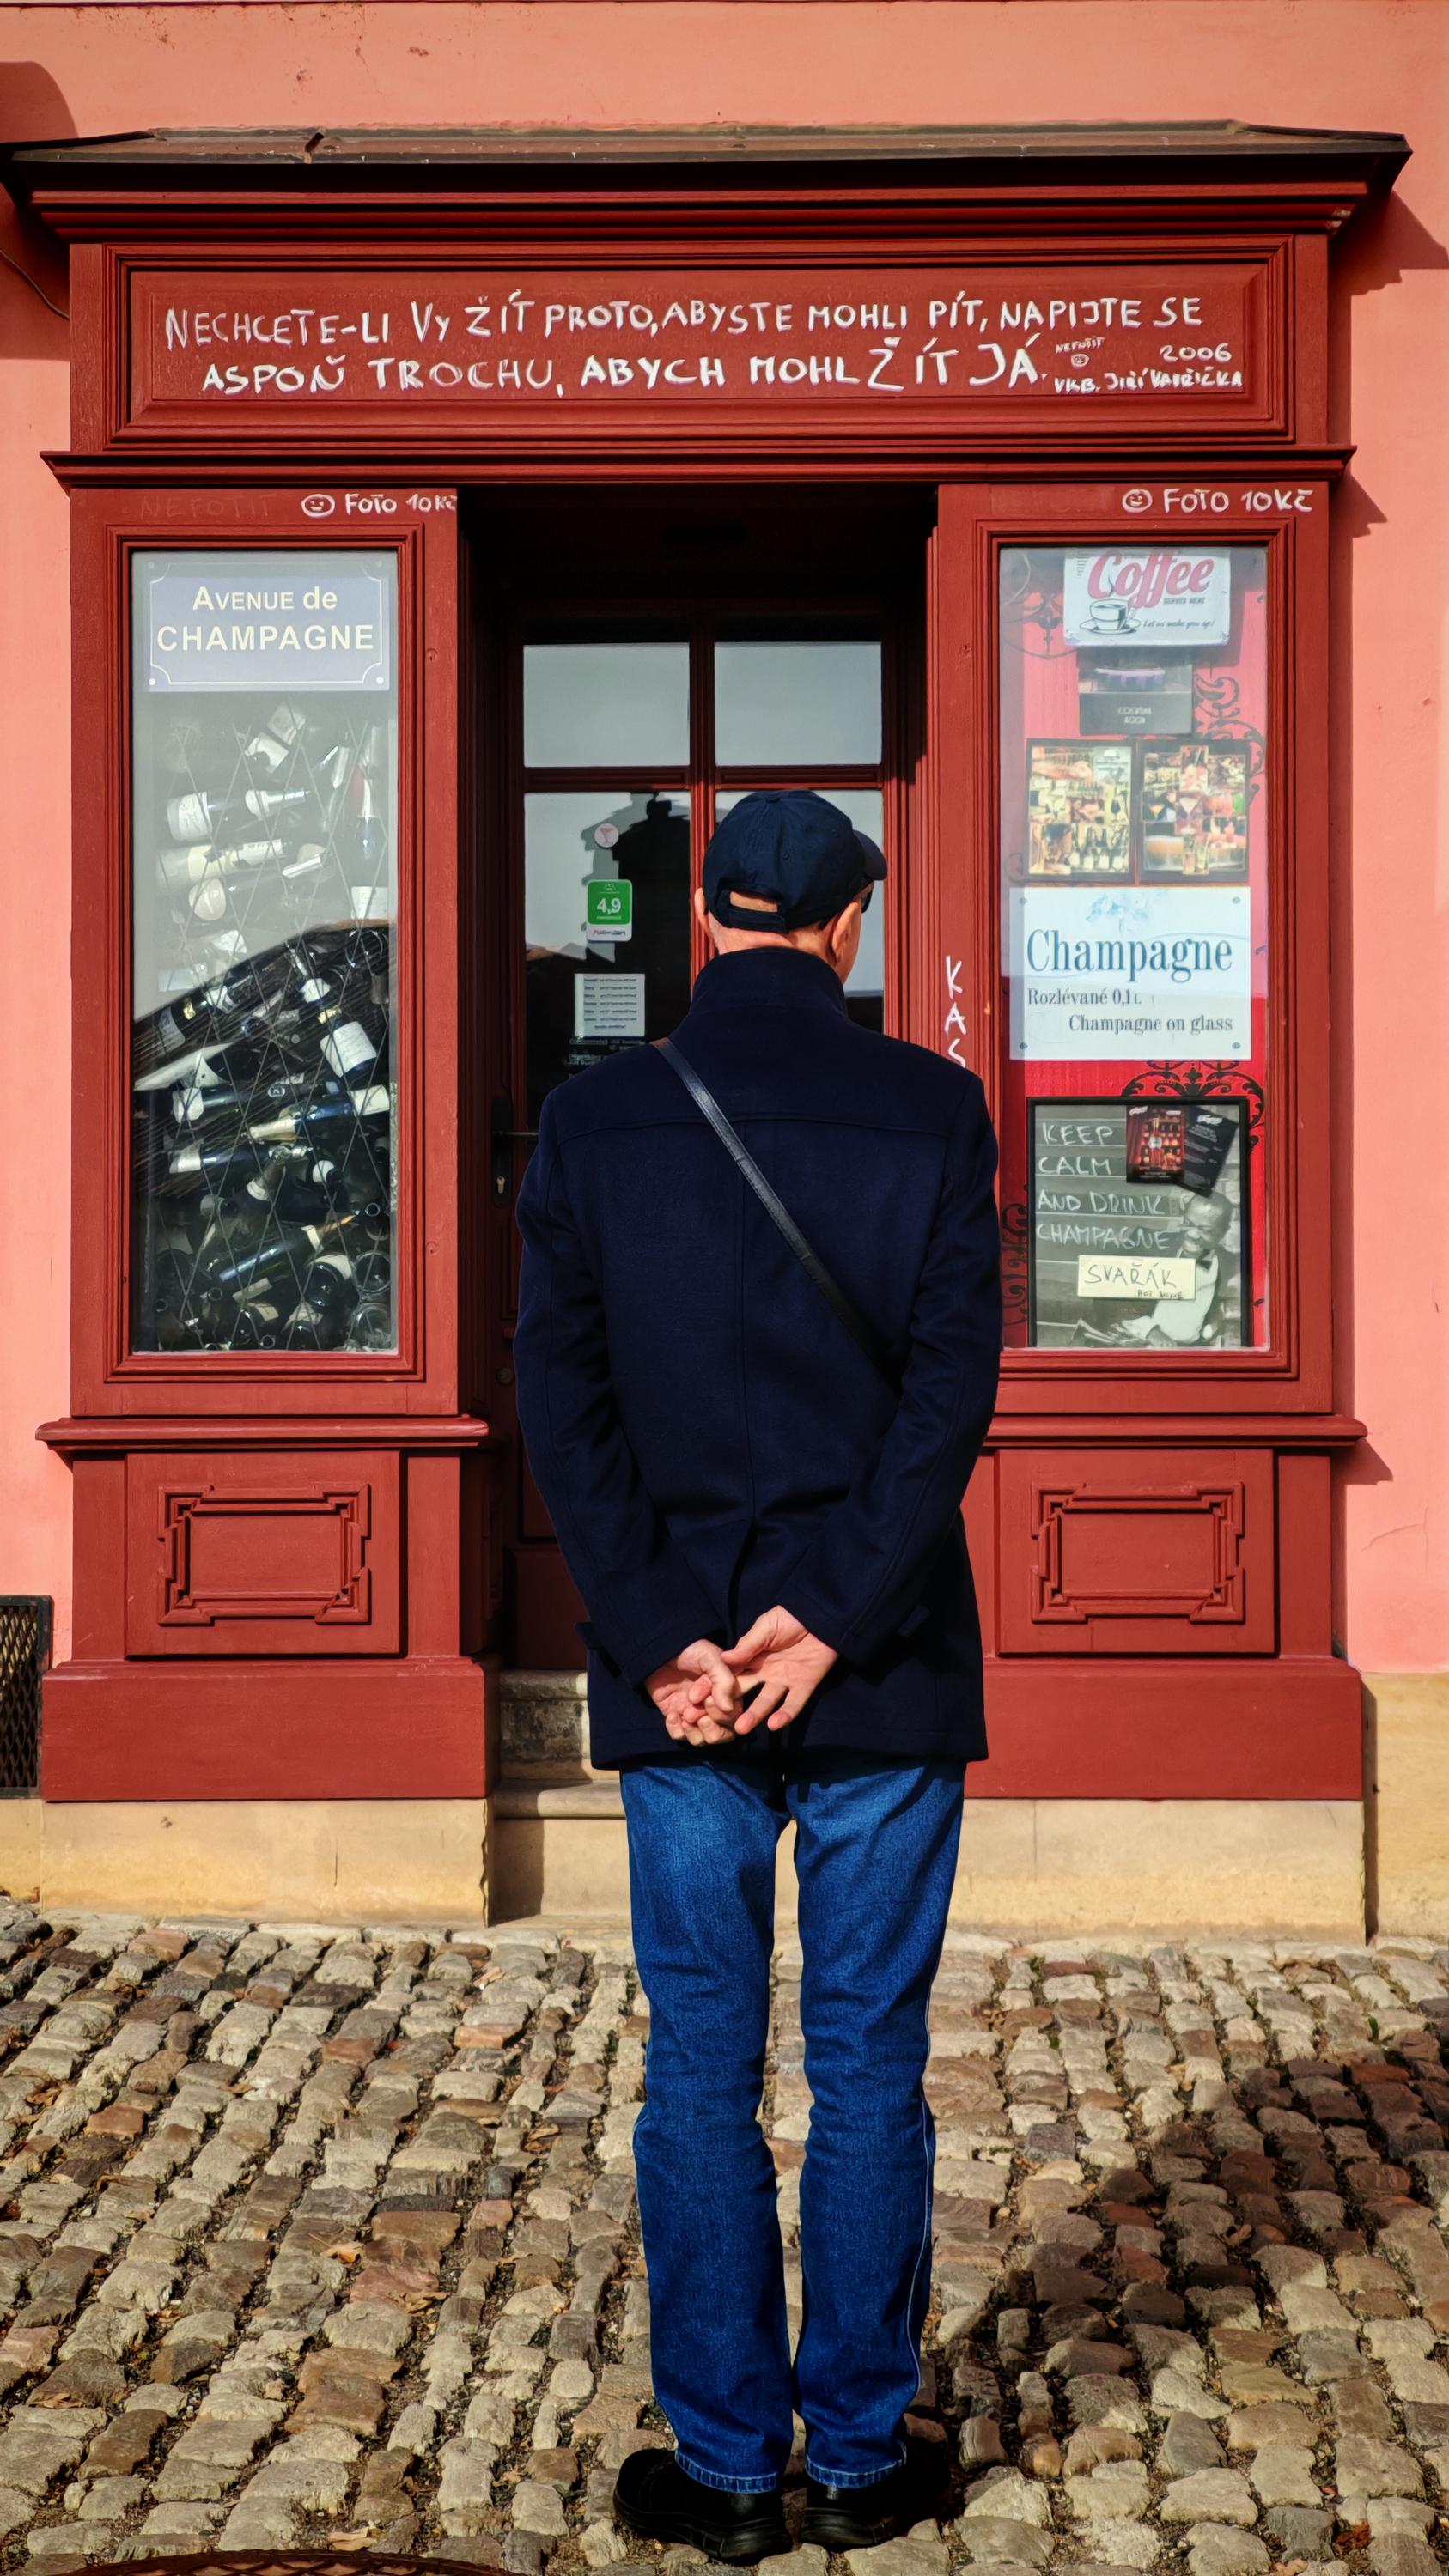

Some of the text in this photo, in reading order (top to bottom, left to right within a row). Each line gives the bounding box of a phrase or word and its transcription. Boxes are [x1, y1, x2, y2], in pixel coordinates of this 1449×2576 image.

[165, 308, 389, 350] NECHCETE-LI
[464, 289, 535, 338] ŽÍT
[808, 305, 908, 331] MOHLI
[928, 290, 989, 333] PÍT,
[1000, 297, 1142, 331] NAPIJTE
[1153, 296, 1202, 326] SE
[1160, 343, 1232, 362] 2006
[202, 355, 346, 395] ASPOŇ
[367, 357, 564, 398] TROCHU,
[581, 355, 726, 391] ABYCH
[749, 355, 861, 386] MOHL
[867, 337, 959, 392] ŽÍT
[1087, 550, 1215, 608] Coffee
[302, 586, 338, 611] de
[157, 624, 374, 652] CHAMPAGNE
[596, 897, 622, 915] 4,9
[1026, 928, 1233, 983] Champagne
[1027, 987, 1108, 1005] Rozlévané
[1068, 1014, 1233, 1036] Champagne on glass
[1041, 1121, 1114, 1146] KEEP
[1038, 1156, 1112, 1176] CALM
[1038, 1188, 1166, 1215] AND DRINK
[1036, 1223, 1170, 1250] CHAMPAGNE
[1084, 1261, 1177, 1289] SVAŘÁK
